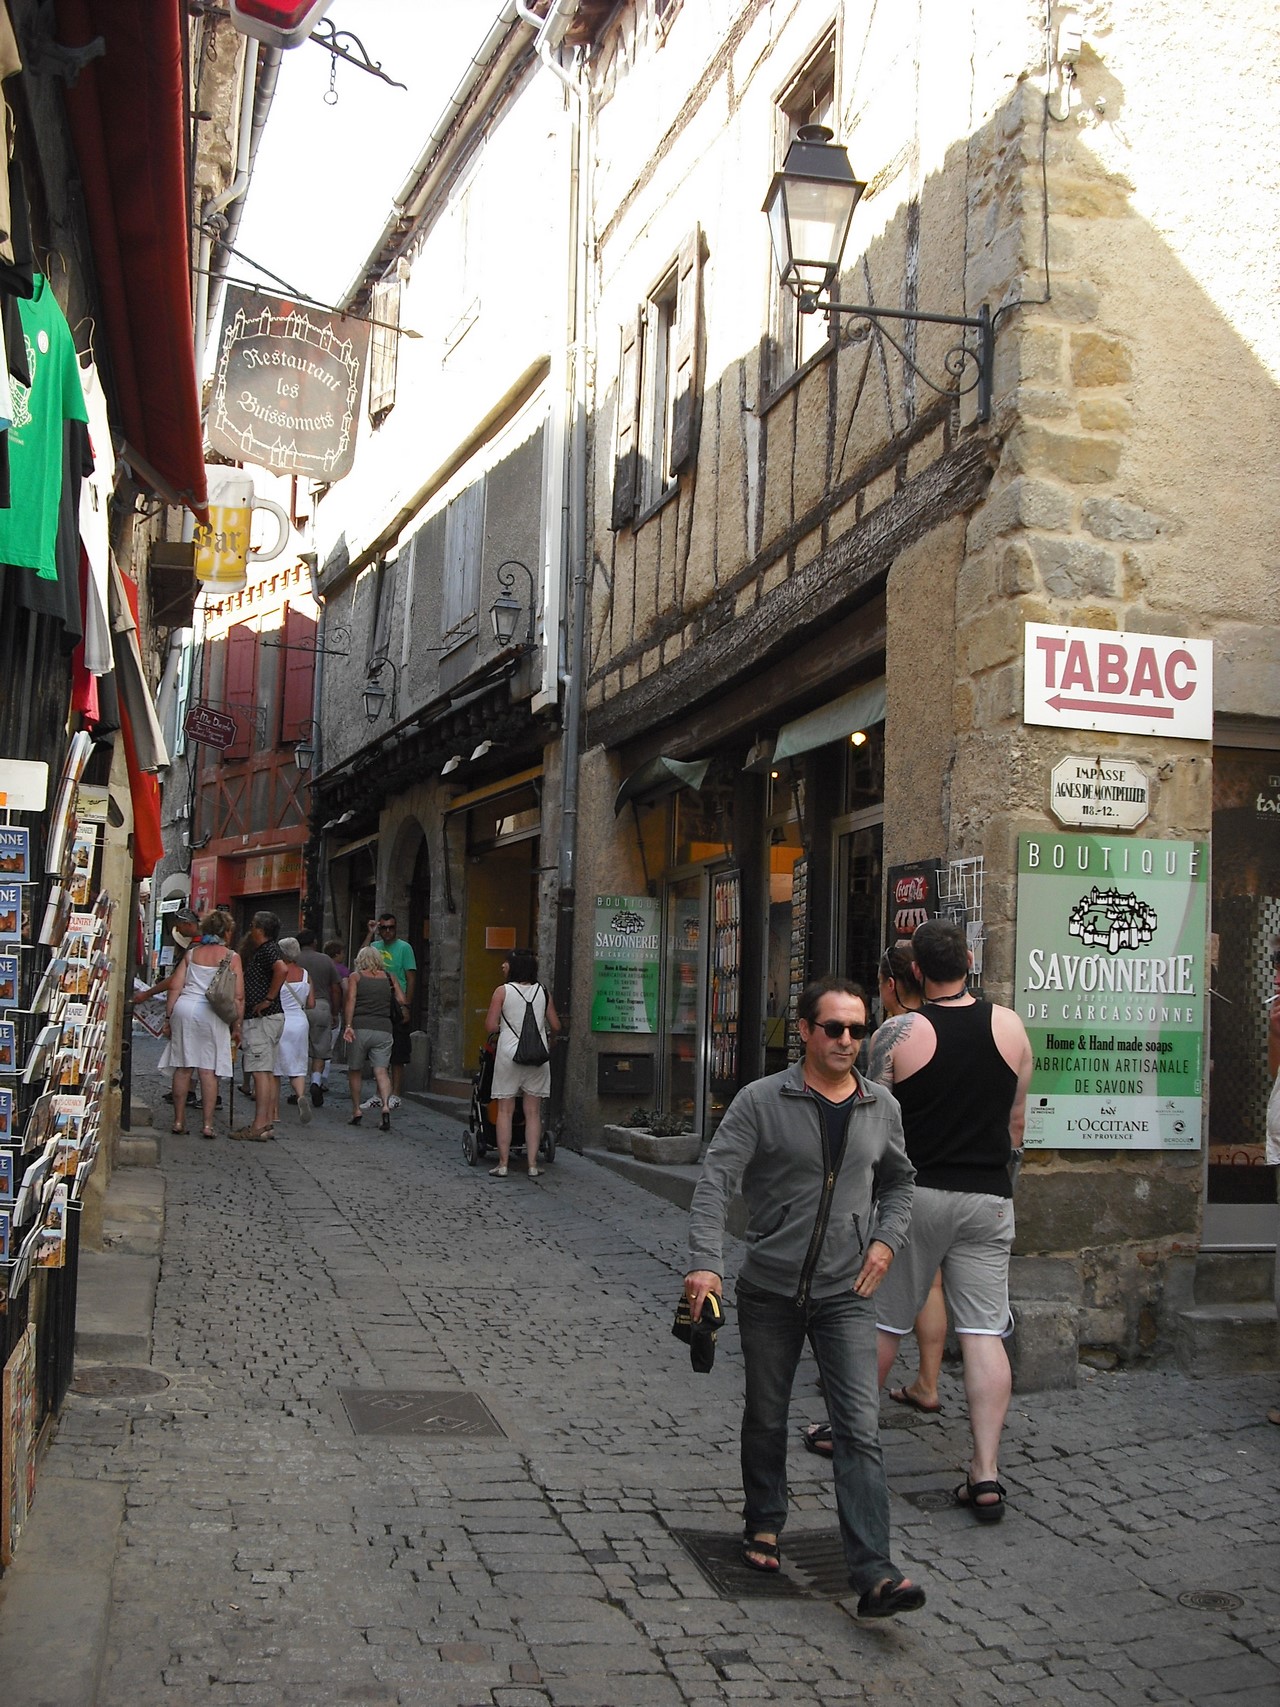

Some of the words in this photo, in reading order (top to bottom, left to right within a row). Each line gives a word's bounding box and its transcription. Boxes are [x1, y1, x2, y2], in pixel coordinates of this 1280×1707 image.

[242, 347, 342, 391] Restaurant
[276, 378, 300, 398] les
[237, 390, 335, 431] Buissonnets
[192, 522, 241, 553] Bar
[1036, 636, 1197, 701] TABAC
[1075, 767, 1126, 781] IMPASSE
[1028, 843, 1199, 876] BOUTIQUE
[597, 897, 660, 909] BOUTIQUE
[596, 932, 659, 949] SAVONNERIE
[1028, 949, 1194, 995] SAVONNERIE
[1027, 1003, 1049, 1019] DE
[1062, 1005, 1194, 1023] CARCASSONNE
[1046, 1033, 1075, 1050] Home
[1077, 1034, 1087, 1050] &
[1089, 1035, 1115, 1051] Hand
[1117, 1036, 1143, 1052] made
[1145, 1038, 1173, 1055] soaps
[1115, 1058, 1189, 1075] ARTISANALE
[1074, 1078, 1090, 1093] DE
[1095, 1079, 1144, 1094] SAVONS
[1067, 1117, 1149, 1132] L'OCCITANE
